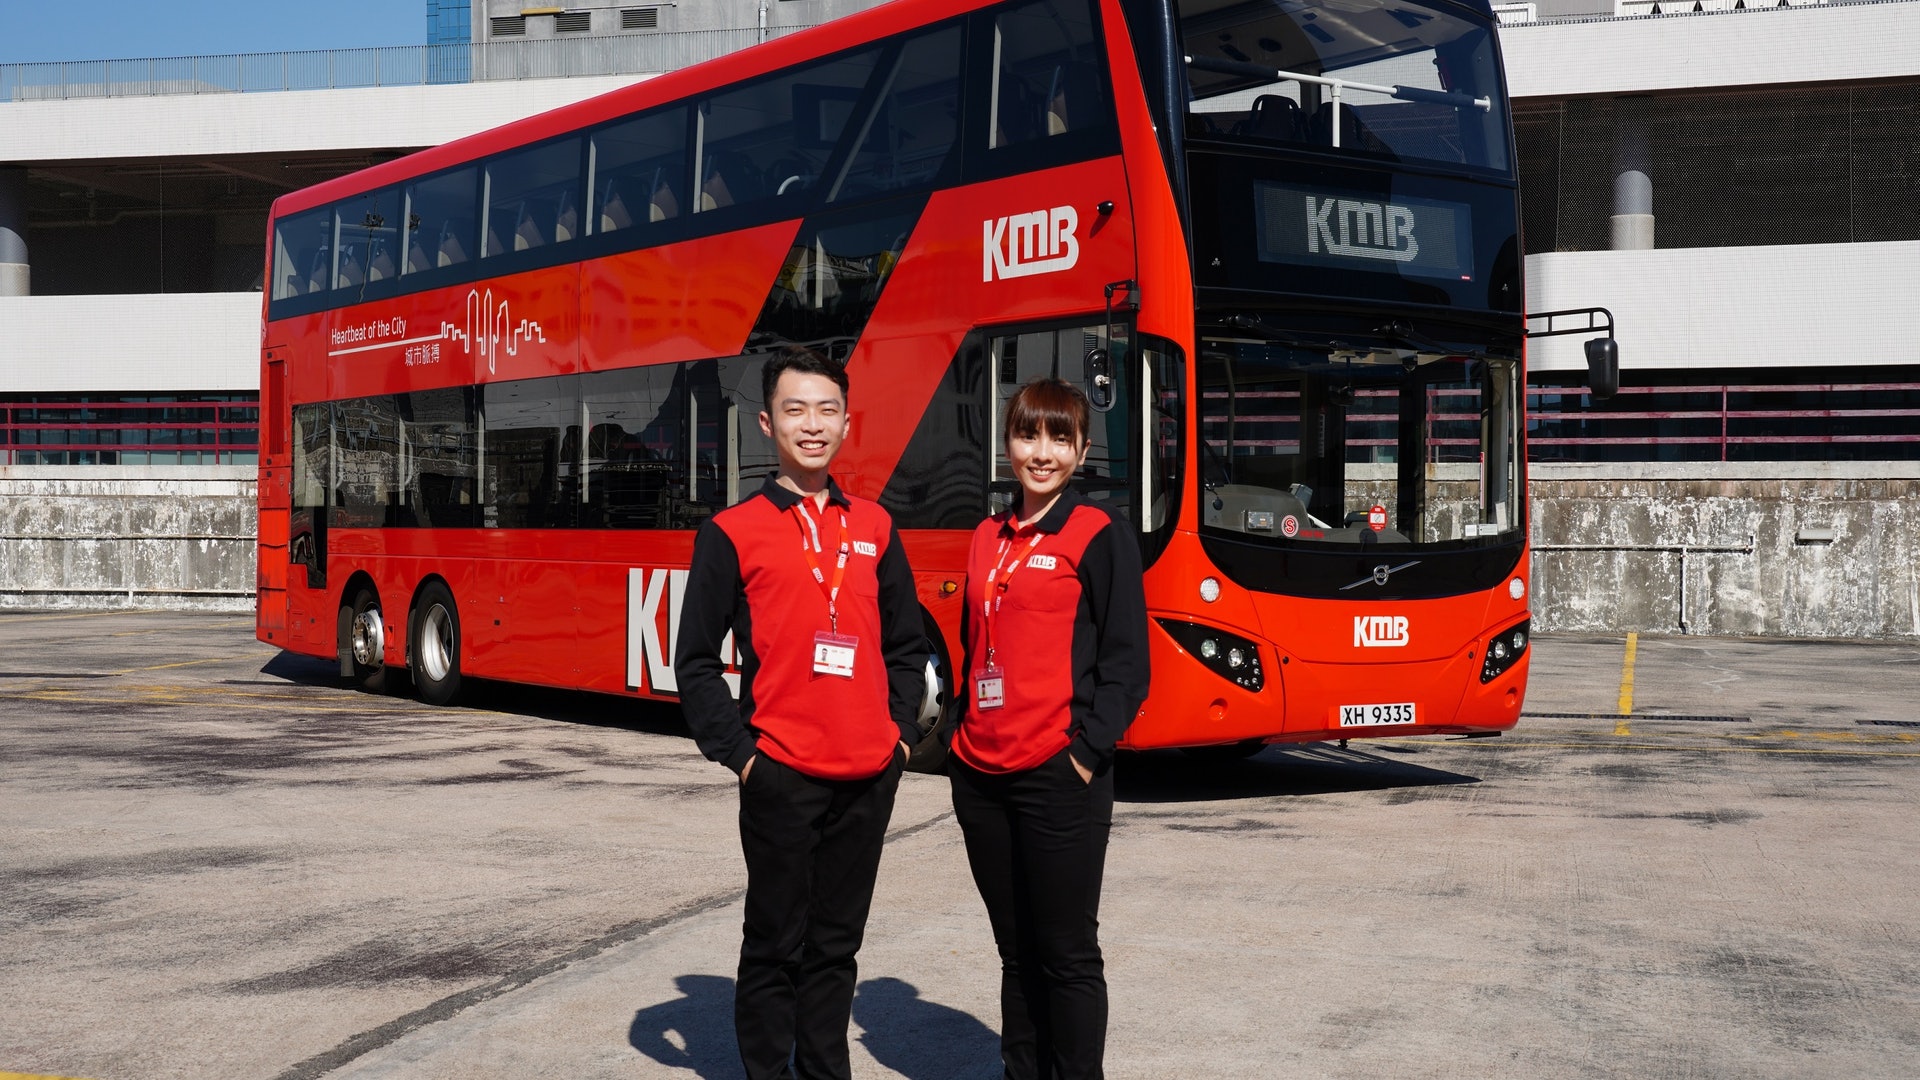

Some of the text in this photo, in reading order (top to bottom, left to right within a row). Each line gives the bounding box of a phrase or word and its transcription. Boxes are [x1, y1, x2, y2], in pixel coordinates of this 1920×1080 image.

[983, 205, 1079, 282] KMB
[1306, 196, 1419, 262] KMB
[332, 316, 407, 345] Heartbeat of the City
[853, 541, 877, 557] KMB
[1353, 616, 1409, 647] KMB
[1344, 704, 1412, 725] XH 9335
